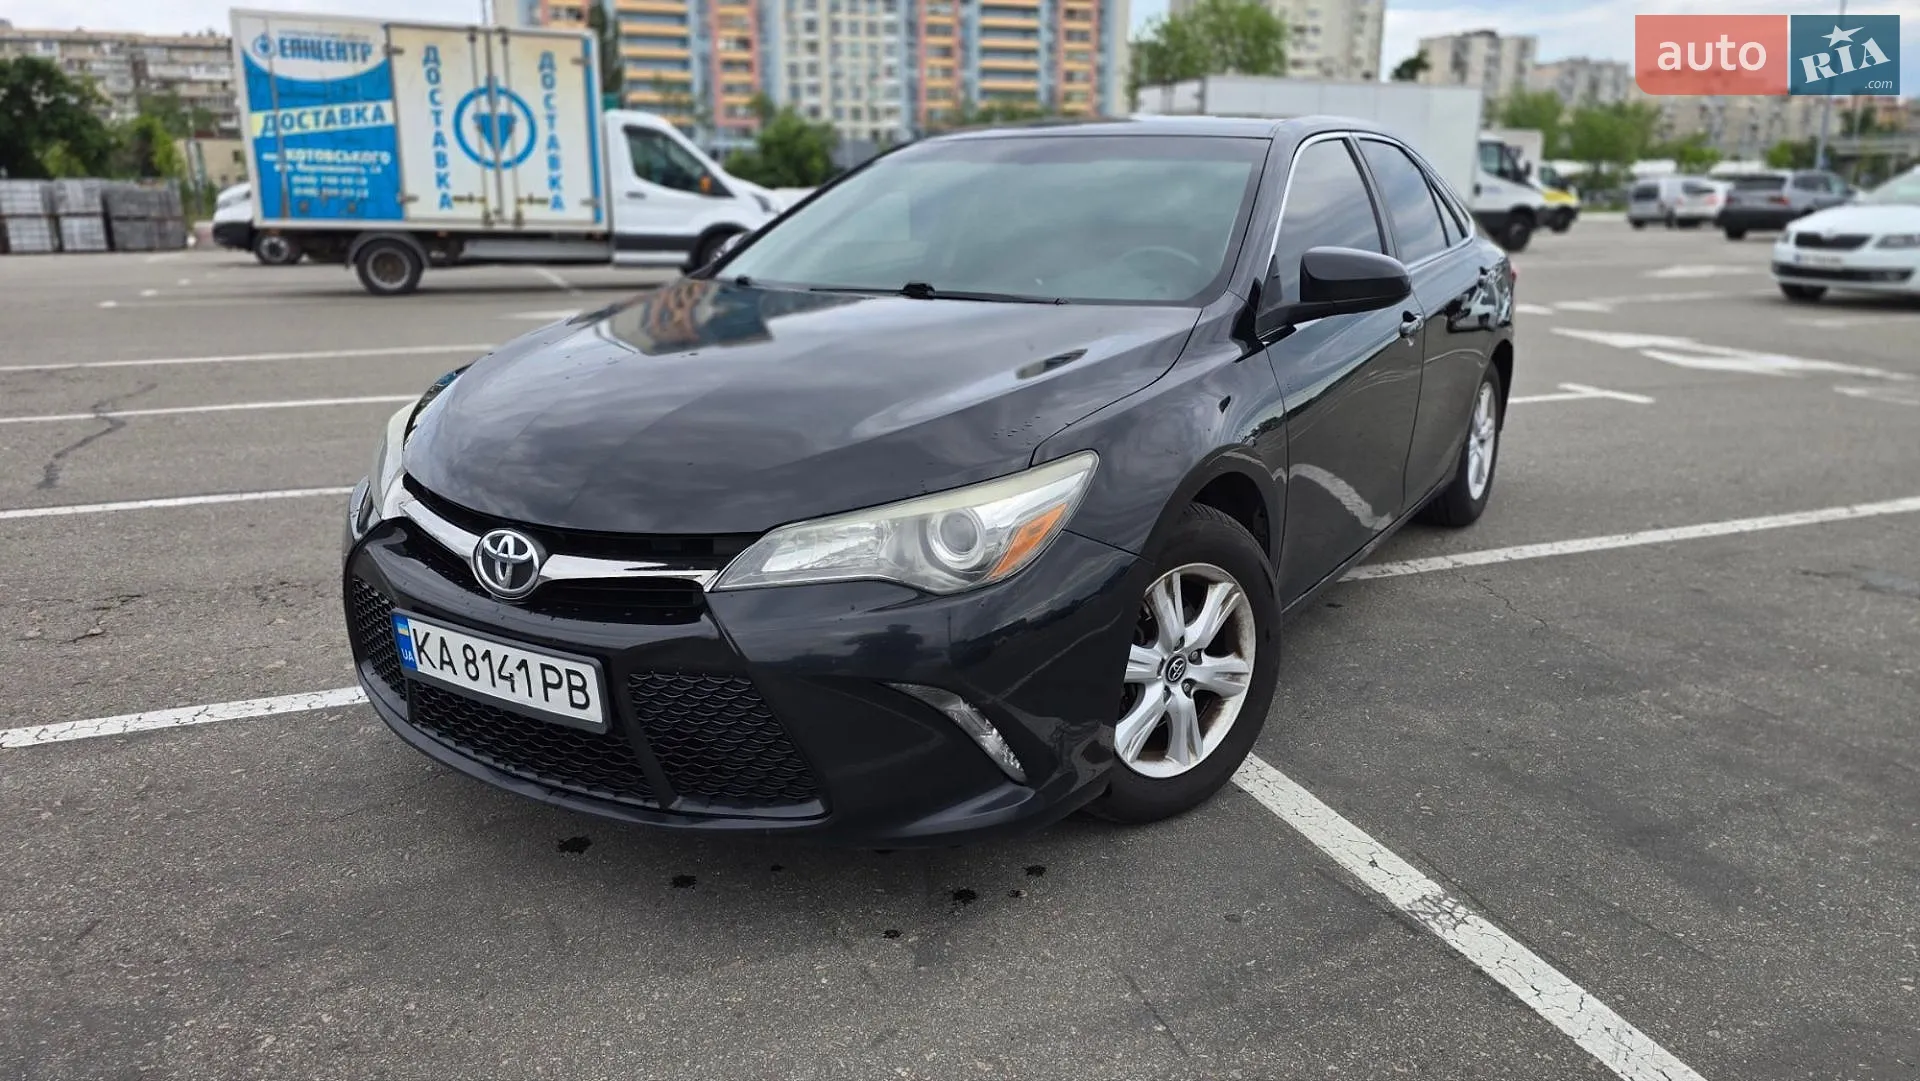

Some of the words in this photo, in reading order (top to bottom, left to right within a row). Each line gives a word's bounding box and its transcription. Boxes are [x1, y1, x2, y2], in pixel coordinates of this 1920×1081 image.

[279, 37, 372, 62] ЕПІЦЕНТР
[262, 103, 387, 138] ДОСТАВКА
[423, 45, 453, 210] ДОСТАВКА
[538, 50, 564, 211] ДОСТАВКА
[401, 647, 415, 662] UA
[413, 628, 457, 676] KA
[462, 643, 533, 698] 8141
[540, 662, 590, 710] PB
